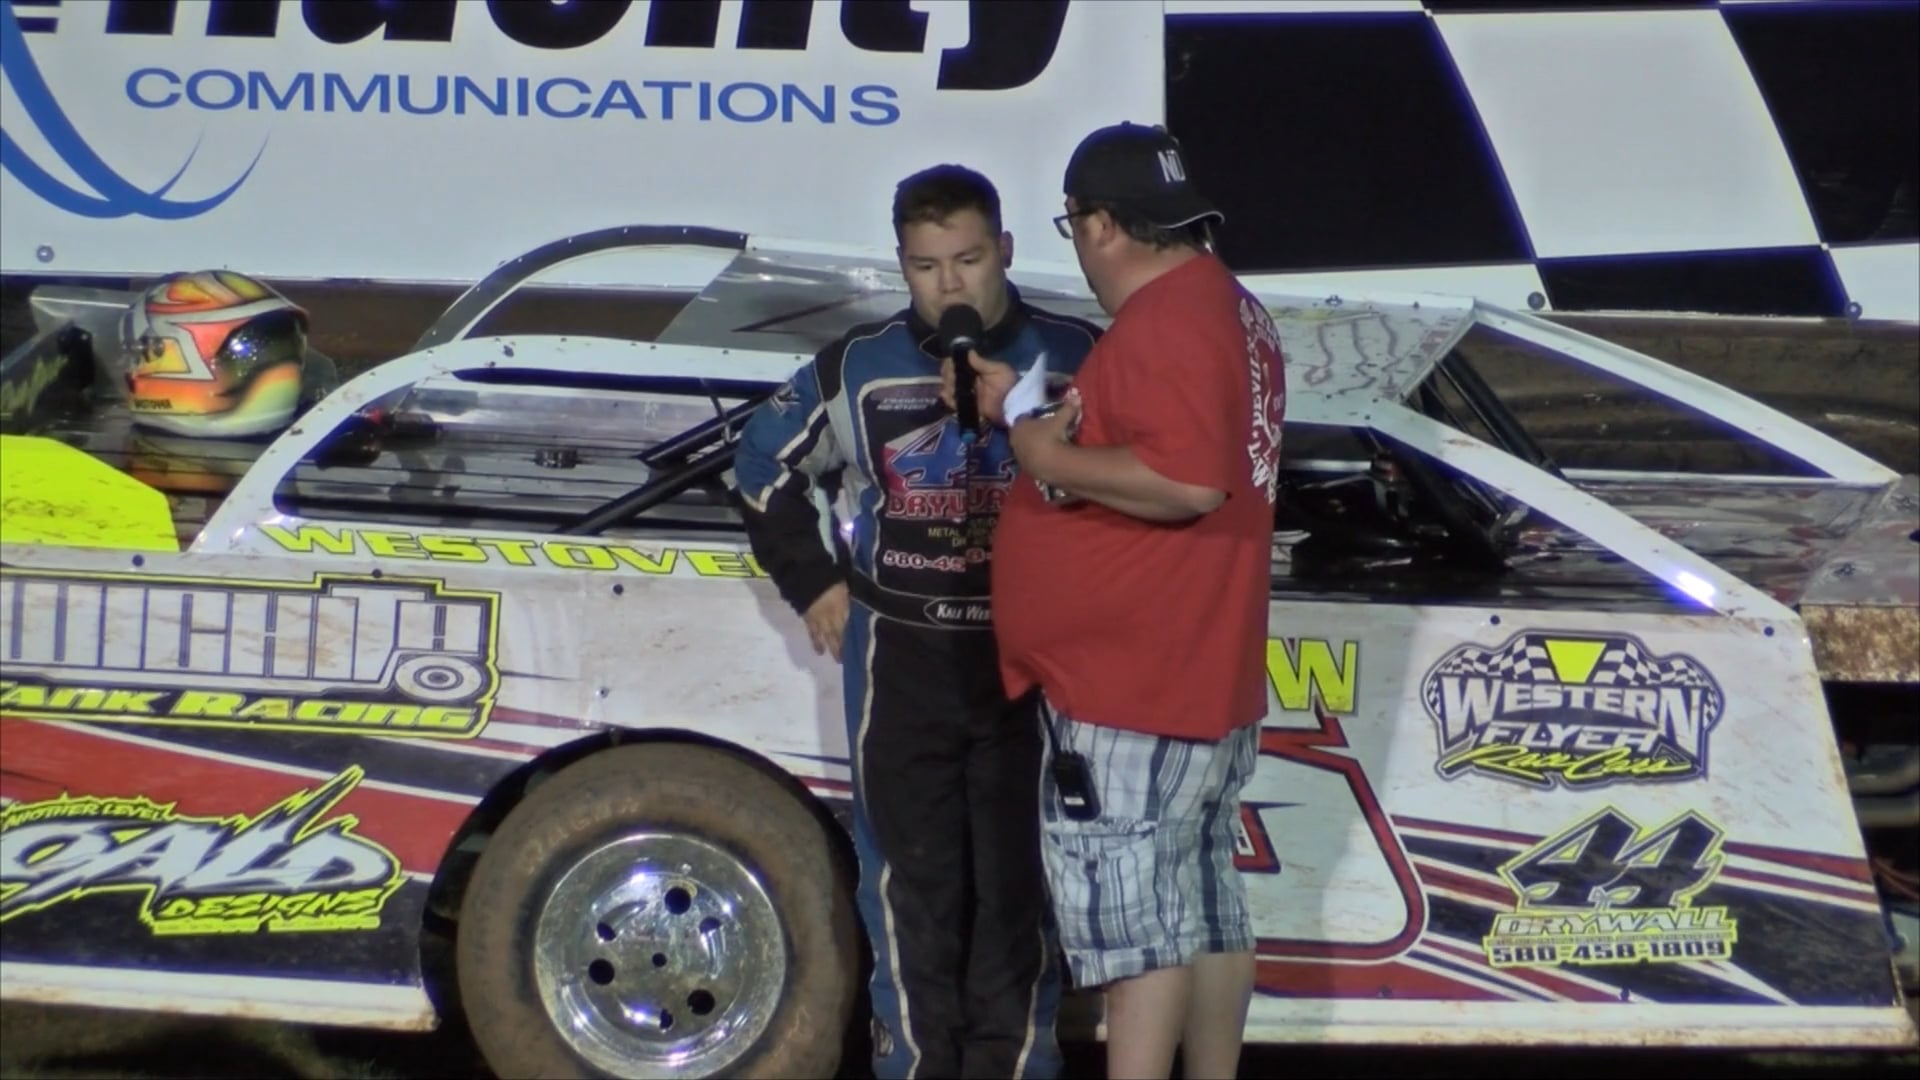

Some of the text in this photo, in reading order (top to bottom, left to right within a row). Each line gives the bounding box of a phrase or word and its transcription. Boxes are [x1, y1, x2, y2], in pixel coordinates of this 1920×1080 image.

[125, 67, 901, 126] COMMUNICATIONS
[885, 482, 1005, 519] DRYWA
[1440, 675, 1704, 764] WESTERN
[1477, 721, 1659, 753] FLYER
[1503, 808, 1722, 908] 44
[1496, 909, 1728, 936] DRYWALL
[1493, 940, 1727, 963] 580-458-1809
